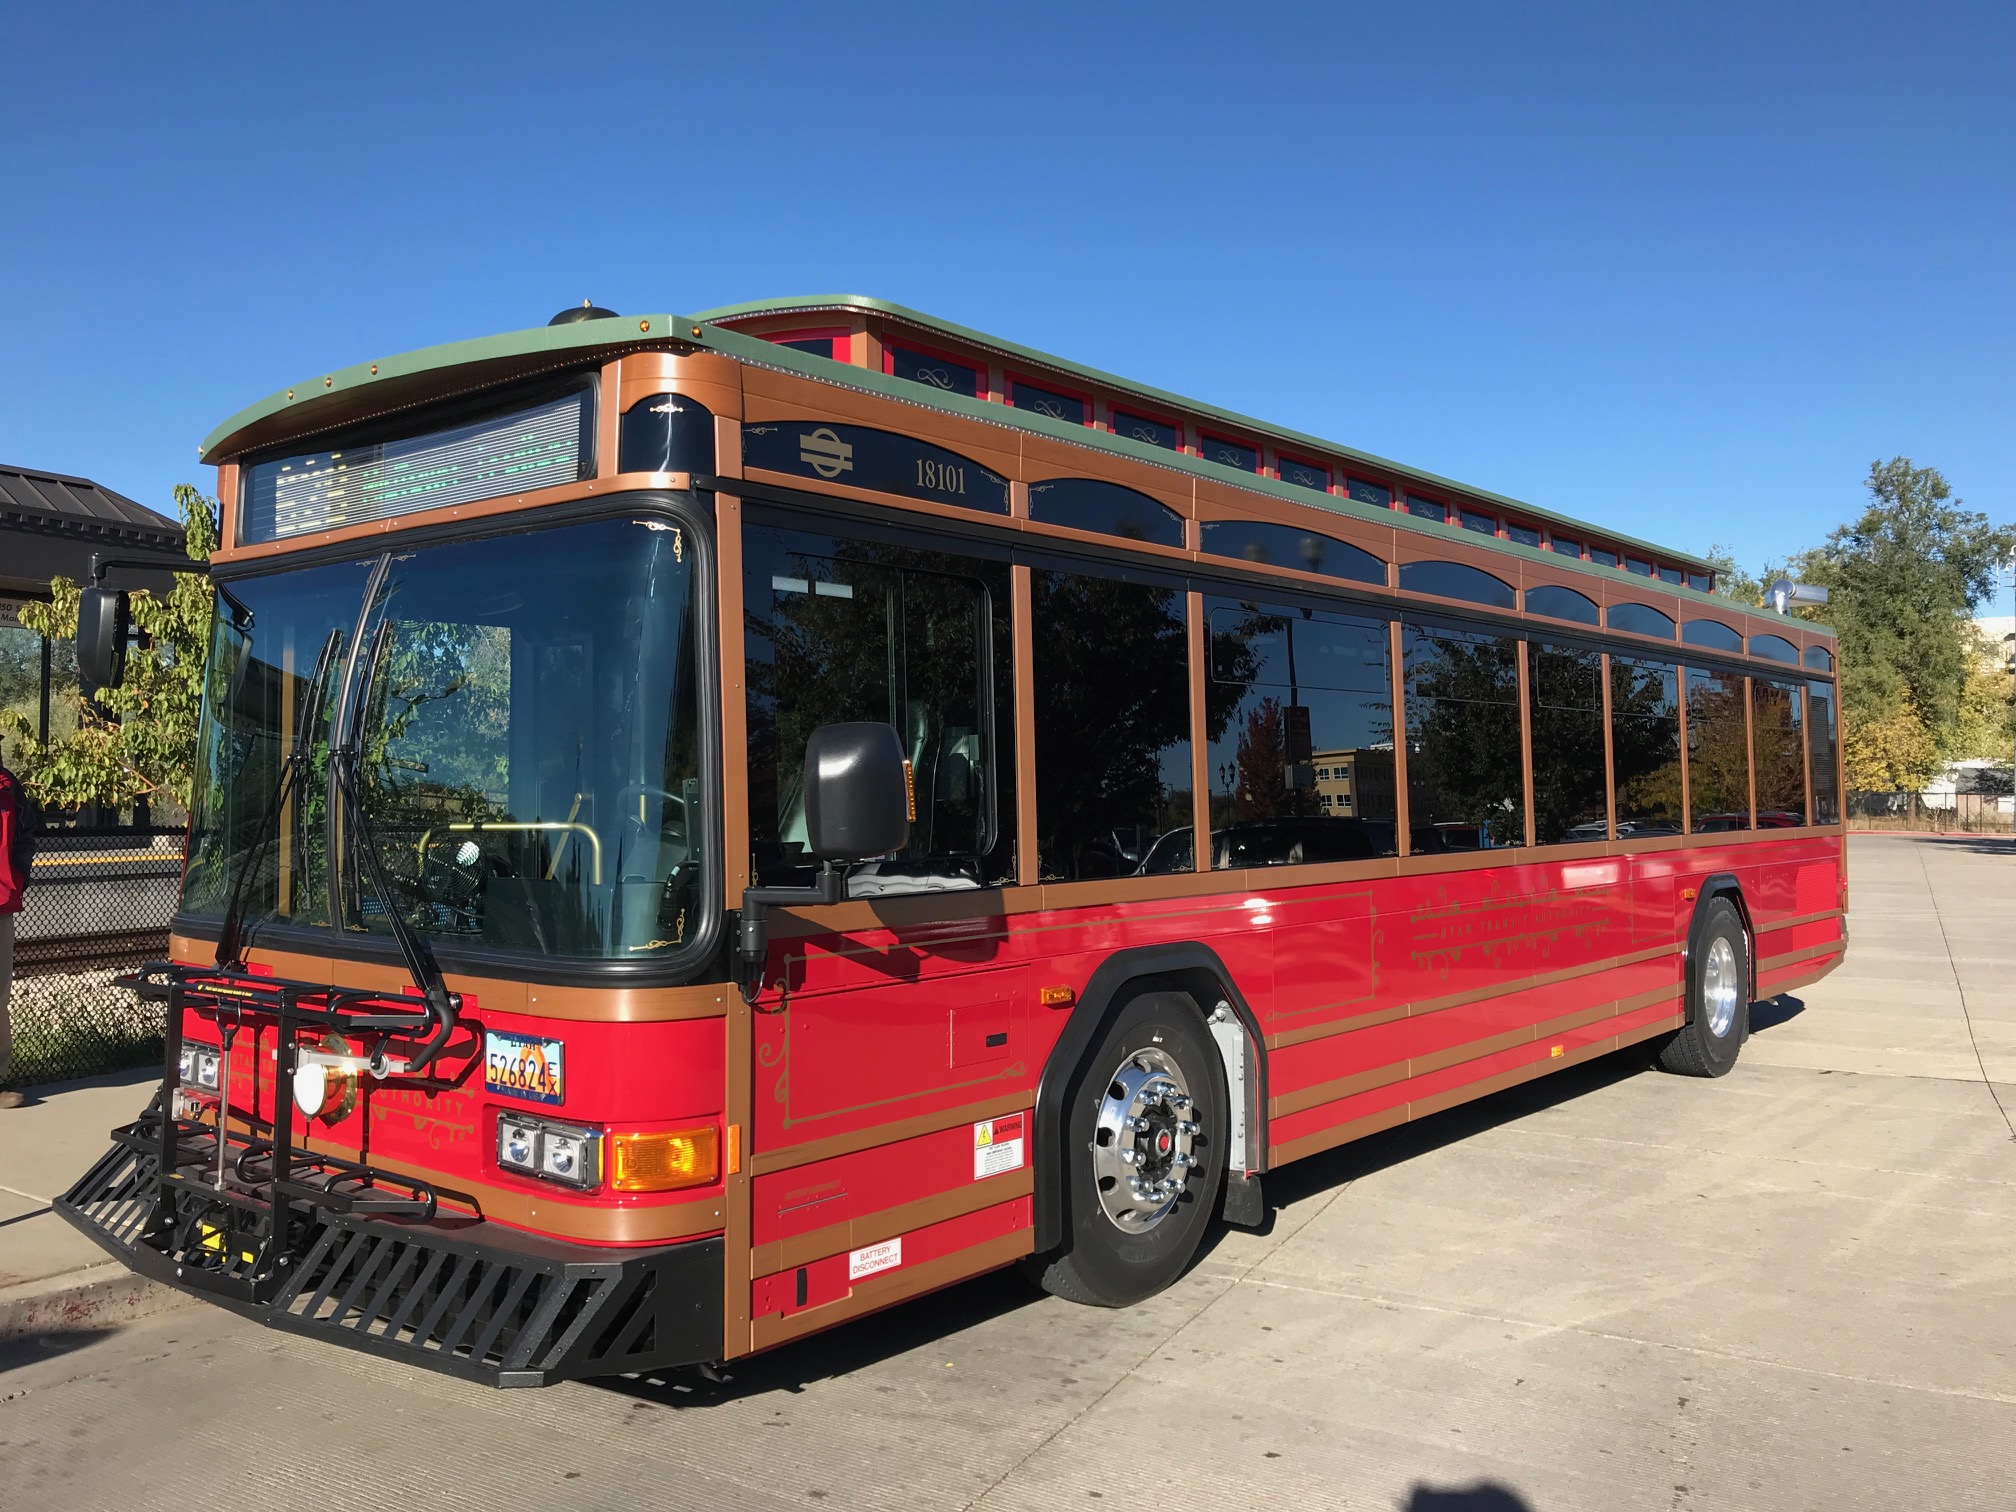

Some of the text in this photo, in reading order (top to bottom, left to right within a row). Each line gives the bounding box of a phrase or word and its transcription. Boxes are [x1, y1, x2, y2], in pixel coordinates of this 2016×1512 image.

[916, 458, 965, 494] 18101
[1441, 905, 1590, 939] UTAH TRANSIT AUTHORITY
[373, 1089, 463, 1116] UTHORITY
[999, 1121, 1022, 1134] WARNING
[853, 1253, 898, 1274] DISCONNECT
[860, 1245, 891, 1262] BATTERY
